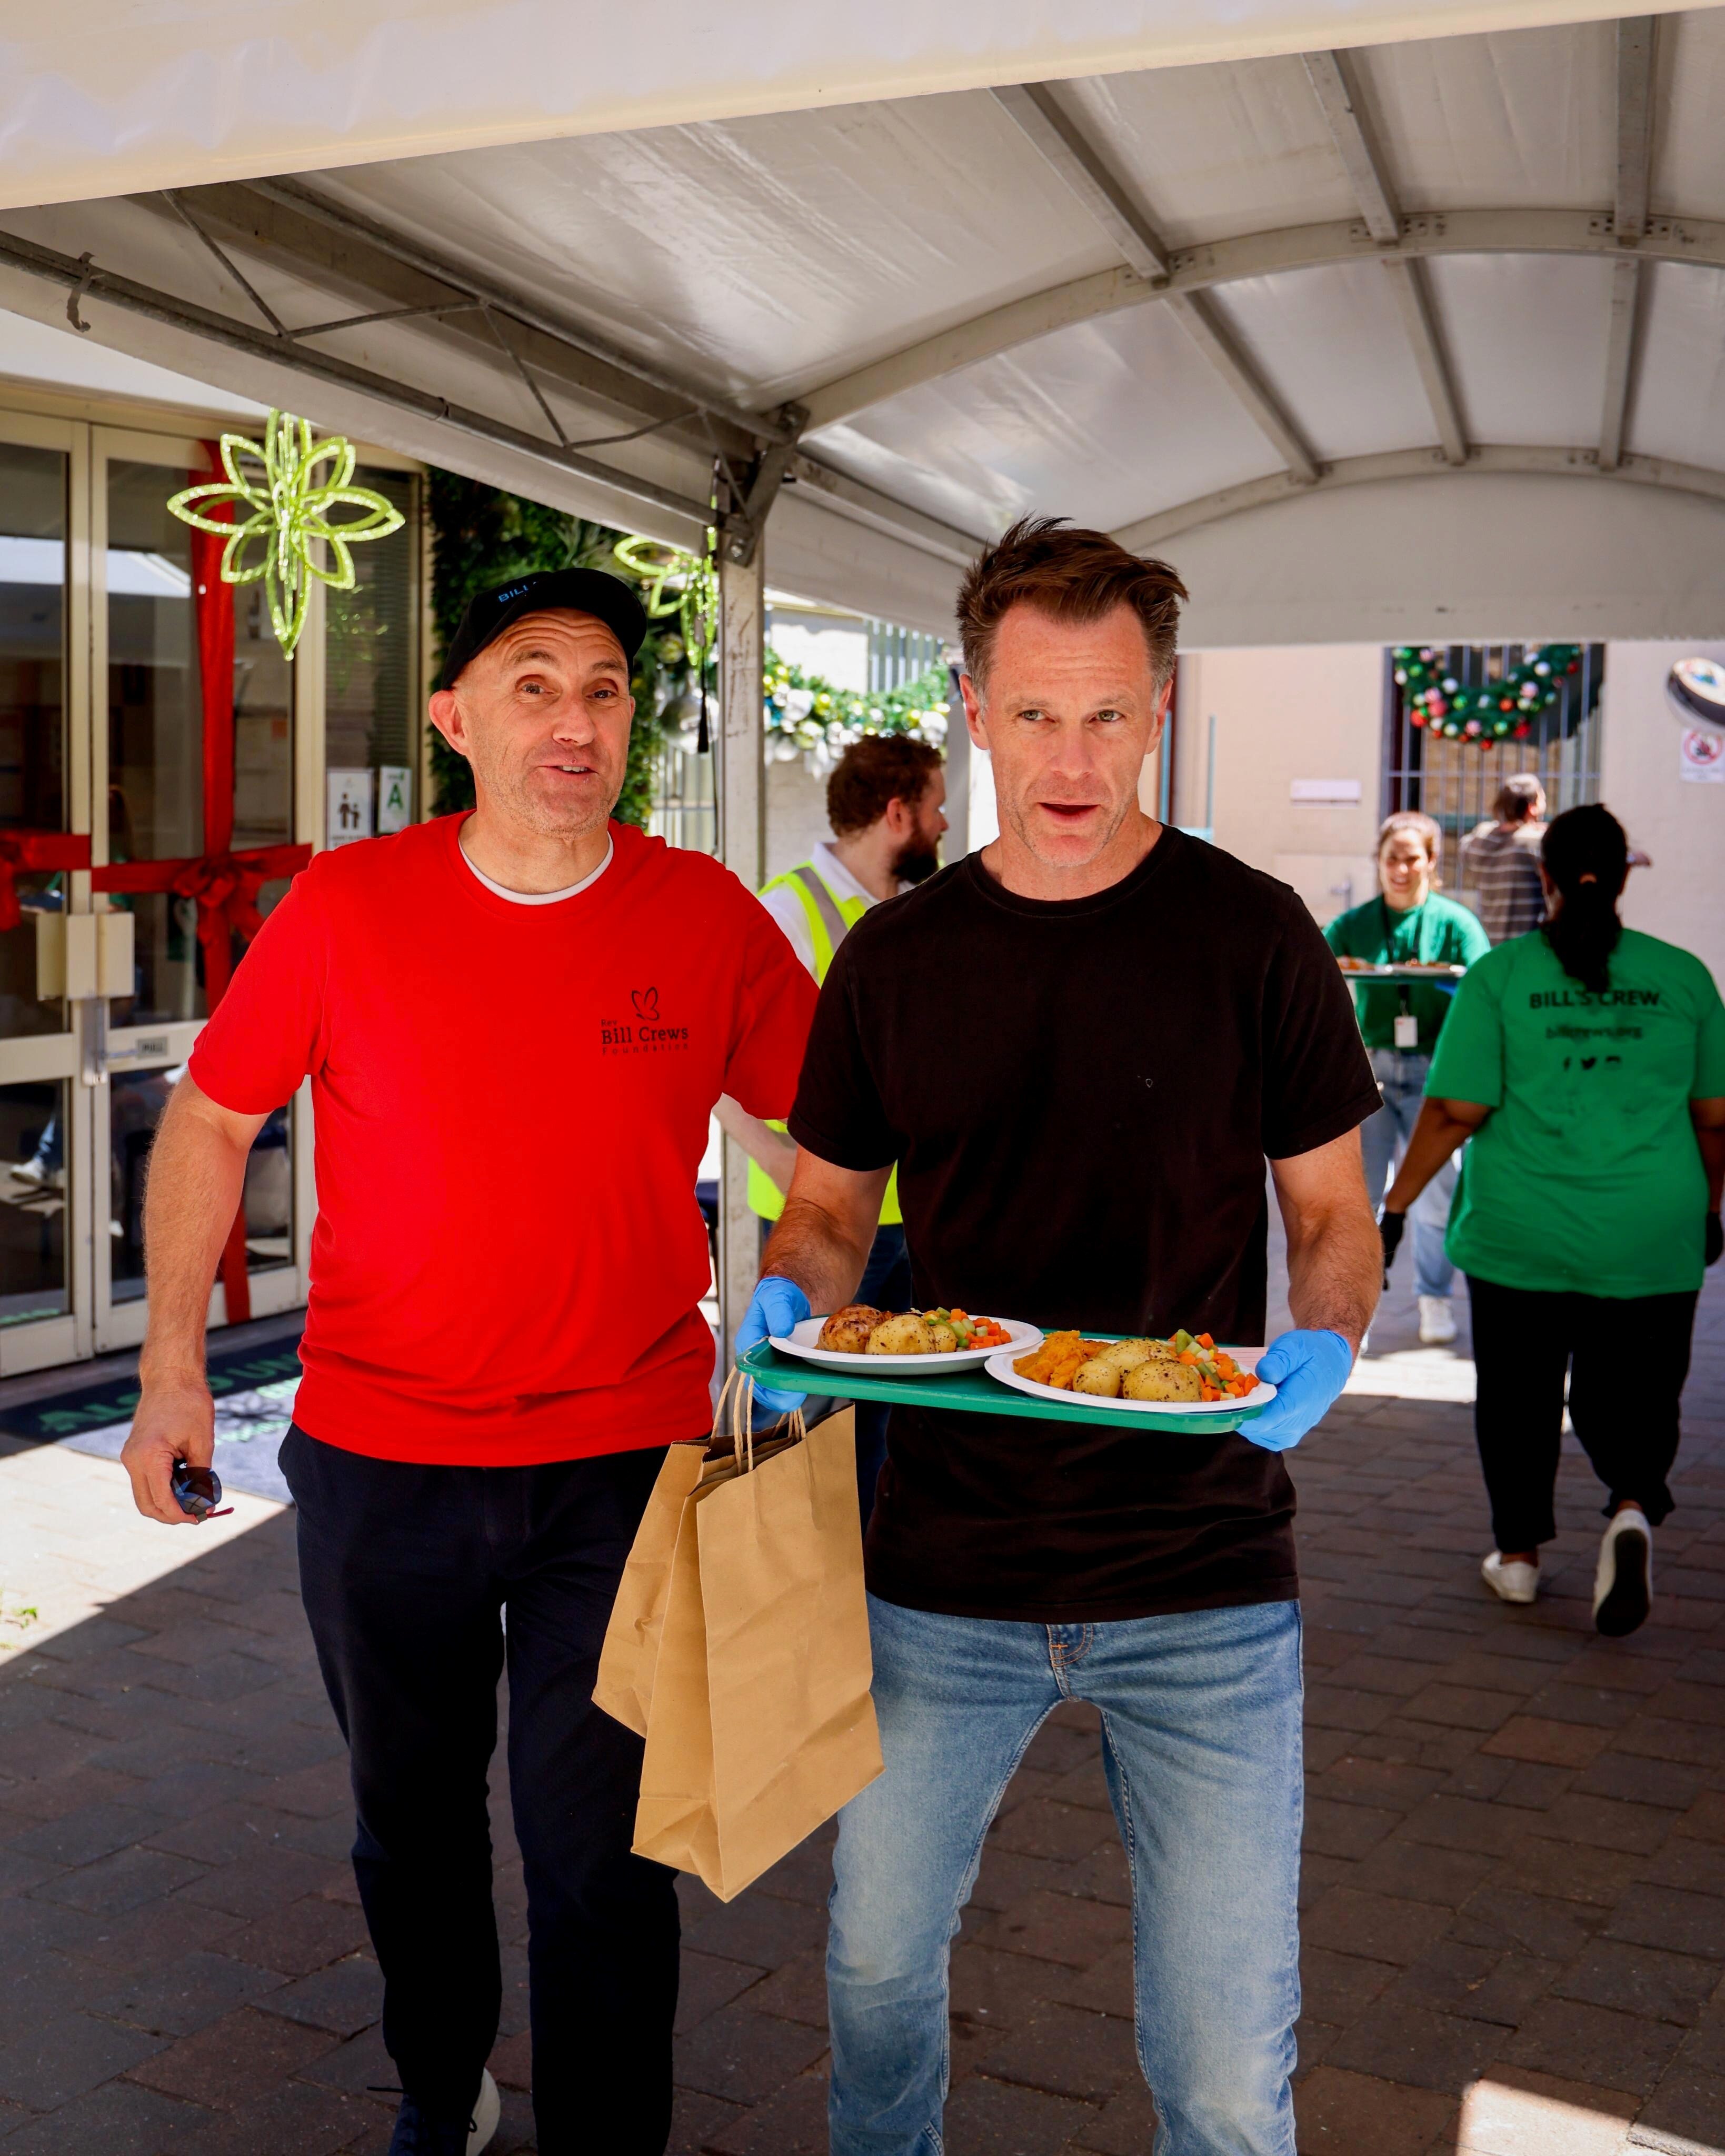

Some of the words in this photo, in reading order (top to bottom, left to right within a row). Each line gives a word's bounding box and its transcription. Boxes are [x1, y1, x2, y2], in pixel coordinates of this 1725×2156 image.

[1598, 990, 1660, 1006] CREW
[602, 1027, 632, 1044] Bill
[639, 1026, 689, 1042] Crews
[602, 1043, 688, 1054] Foundation
